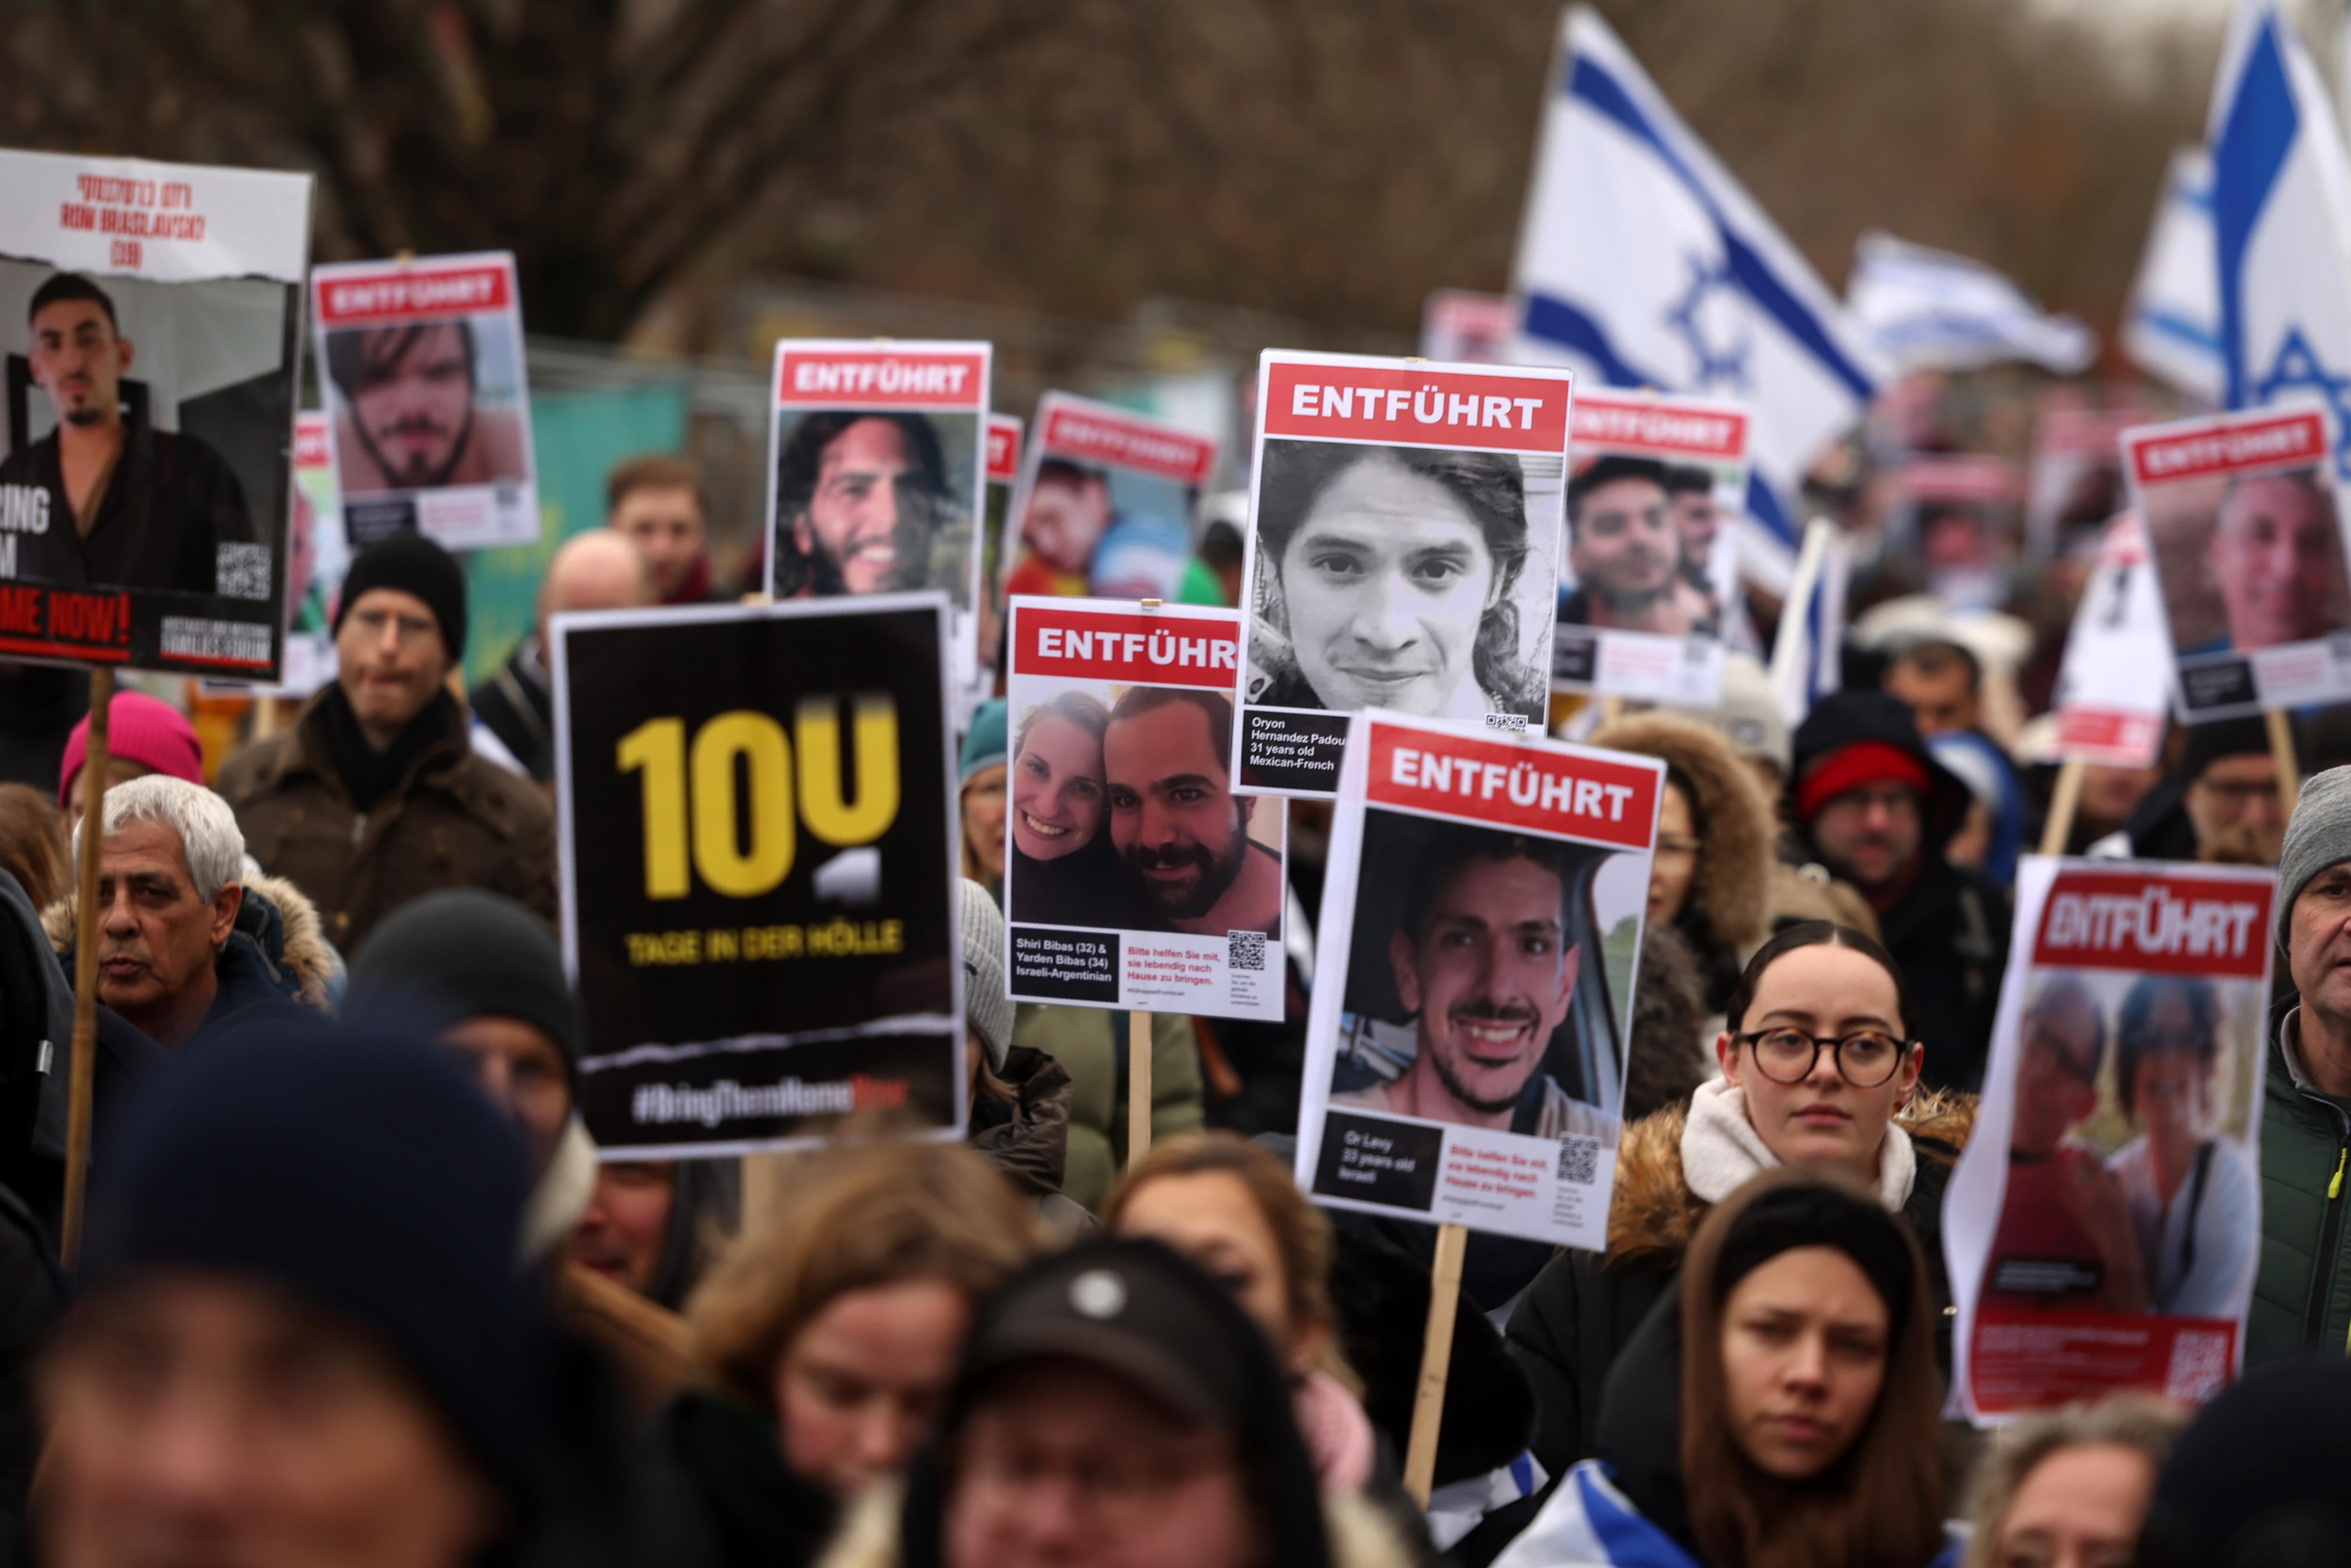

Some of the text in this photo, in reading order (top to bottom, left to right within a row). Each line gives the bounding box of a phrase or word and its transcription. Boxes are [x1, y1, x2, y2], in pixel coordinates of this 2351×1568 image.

[795, 360, 970, 393] ENTFÜHRT
[1292, 384, 1543, 430] ENTFÜHRT
[0, 483, 50, 535] ING
[48, 591, 131, 645] NOW!
[1038, 627, 1237, 669] ENTFÜHR
[1252, 717, 1285, 730] Oryon
[1251, 730, 1347, 746] Hernandez Padou
[1250, 742, 1315, 756] 31 years old
[1250, 755, 1334, 771] Mexican-French
[1391, 747, 1634, 822] ENTFÜHRT
[626, 914, 904, 967] TAGE IN DER HÖLLE
[1016, 938, 1107, 955] Shiri Bibas (32) &
[1016, 952, 1108, 970] Yarden Bibas (34)
[1128, 947, 1221, 962] Bitte helfen Sie mit,
[1016, 966, 1112, 982] Israeli-Argentinian
[1144, 960, 1186, 972] lebendig
[1189, 963, 1212, 973] nach
[1128, 972, 1157, 981] Hause
[1175, 974, 1214, 986] bringen.
[1362, 1133, 1394, 1153] Levy
[1358, 1153, 1393, 1169] years
[1394, 1158, 1416, 1173] old
[1450, 1144, 1474, 1158] Bitte
[1511, 1154, 1527, 1165] Sie
